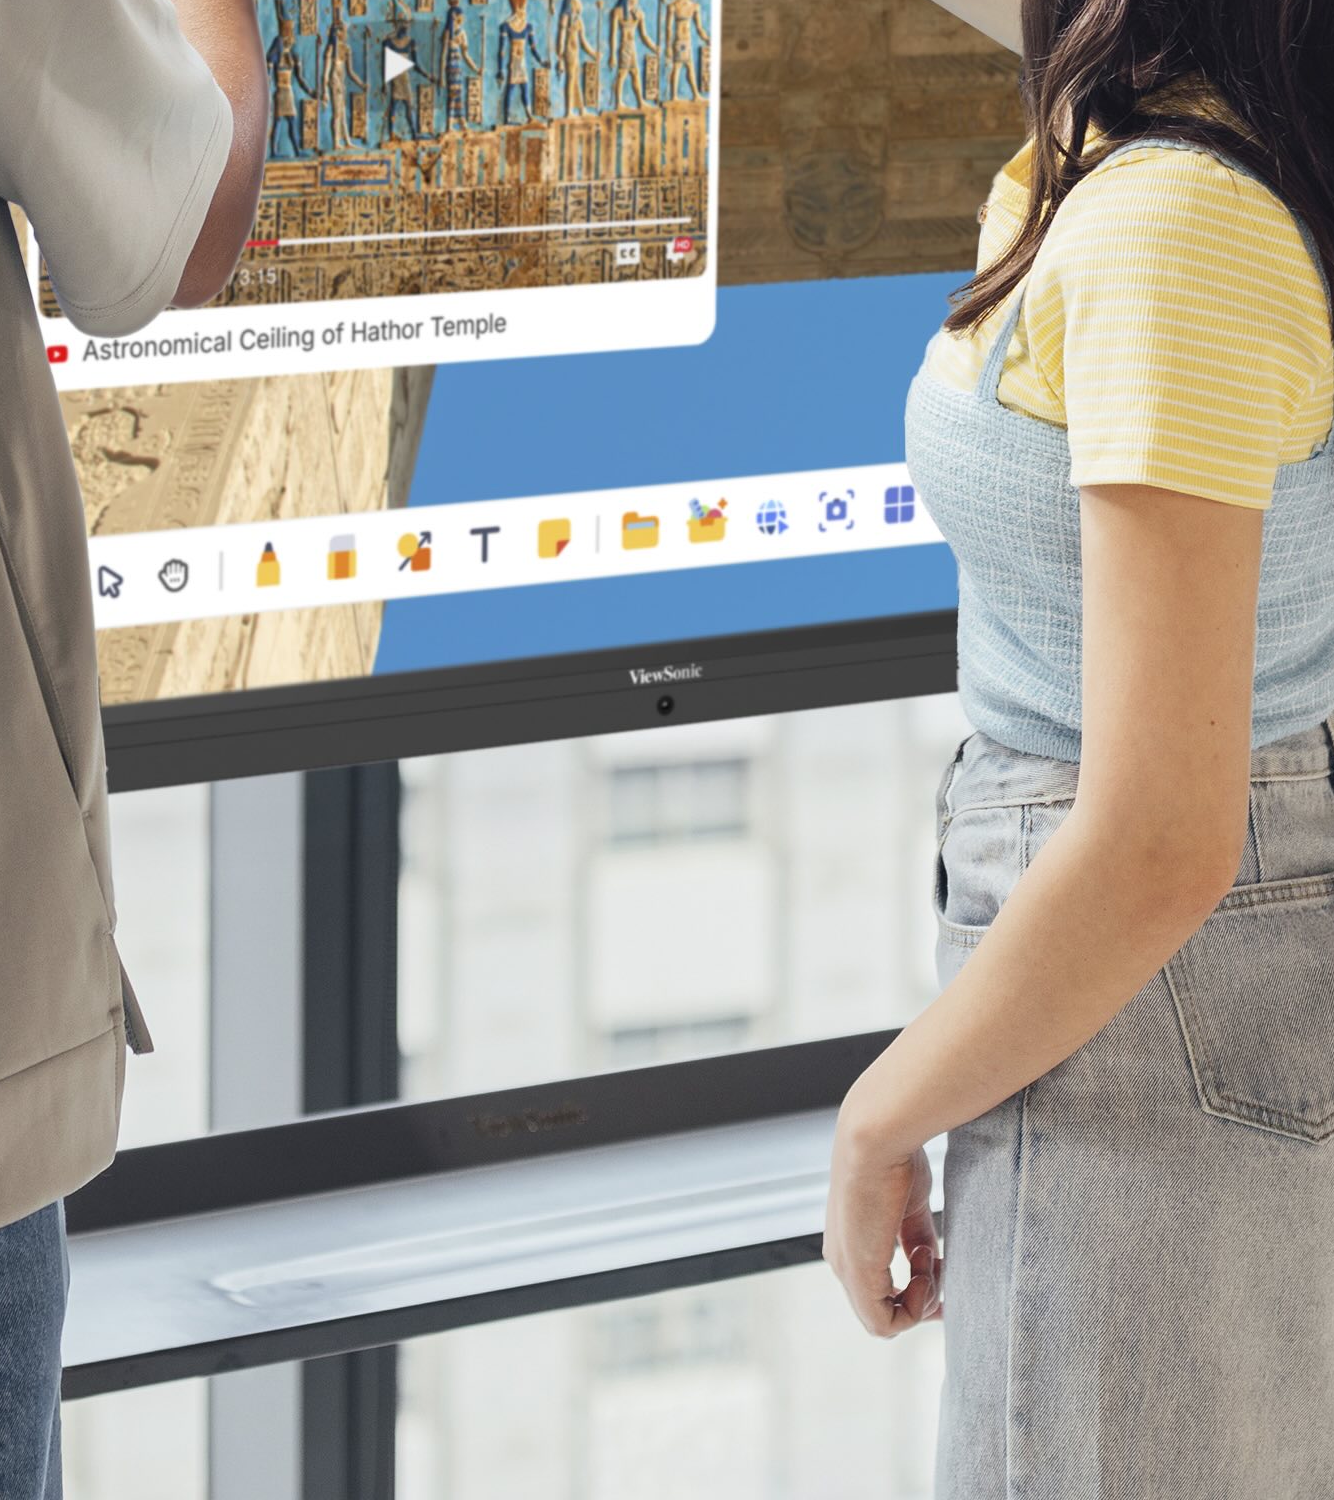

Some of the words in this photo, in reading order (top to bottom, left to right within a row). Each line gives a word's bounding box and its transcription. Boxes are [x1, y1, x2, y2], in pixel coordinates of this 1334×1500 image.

[82, 331, 232, 361] Astronomical
[239, 327, 314, 352] Ceiling
[322, 322, 344, 345] of
[351, 320, 423, 342] Hathor
[431, 314, 507, 339] Temple
[629, 663, 703, 685] ViewSonic
